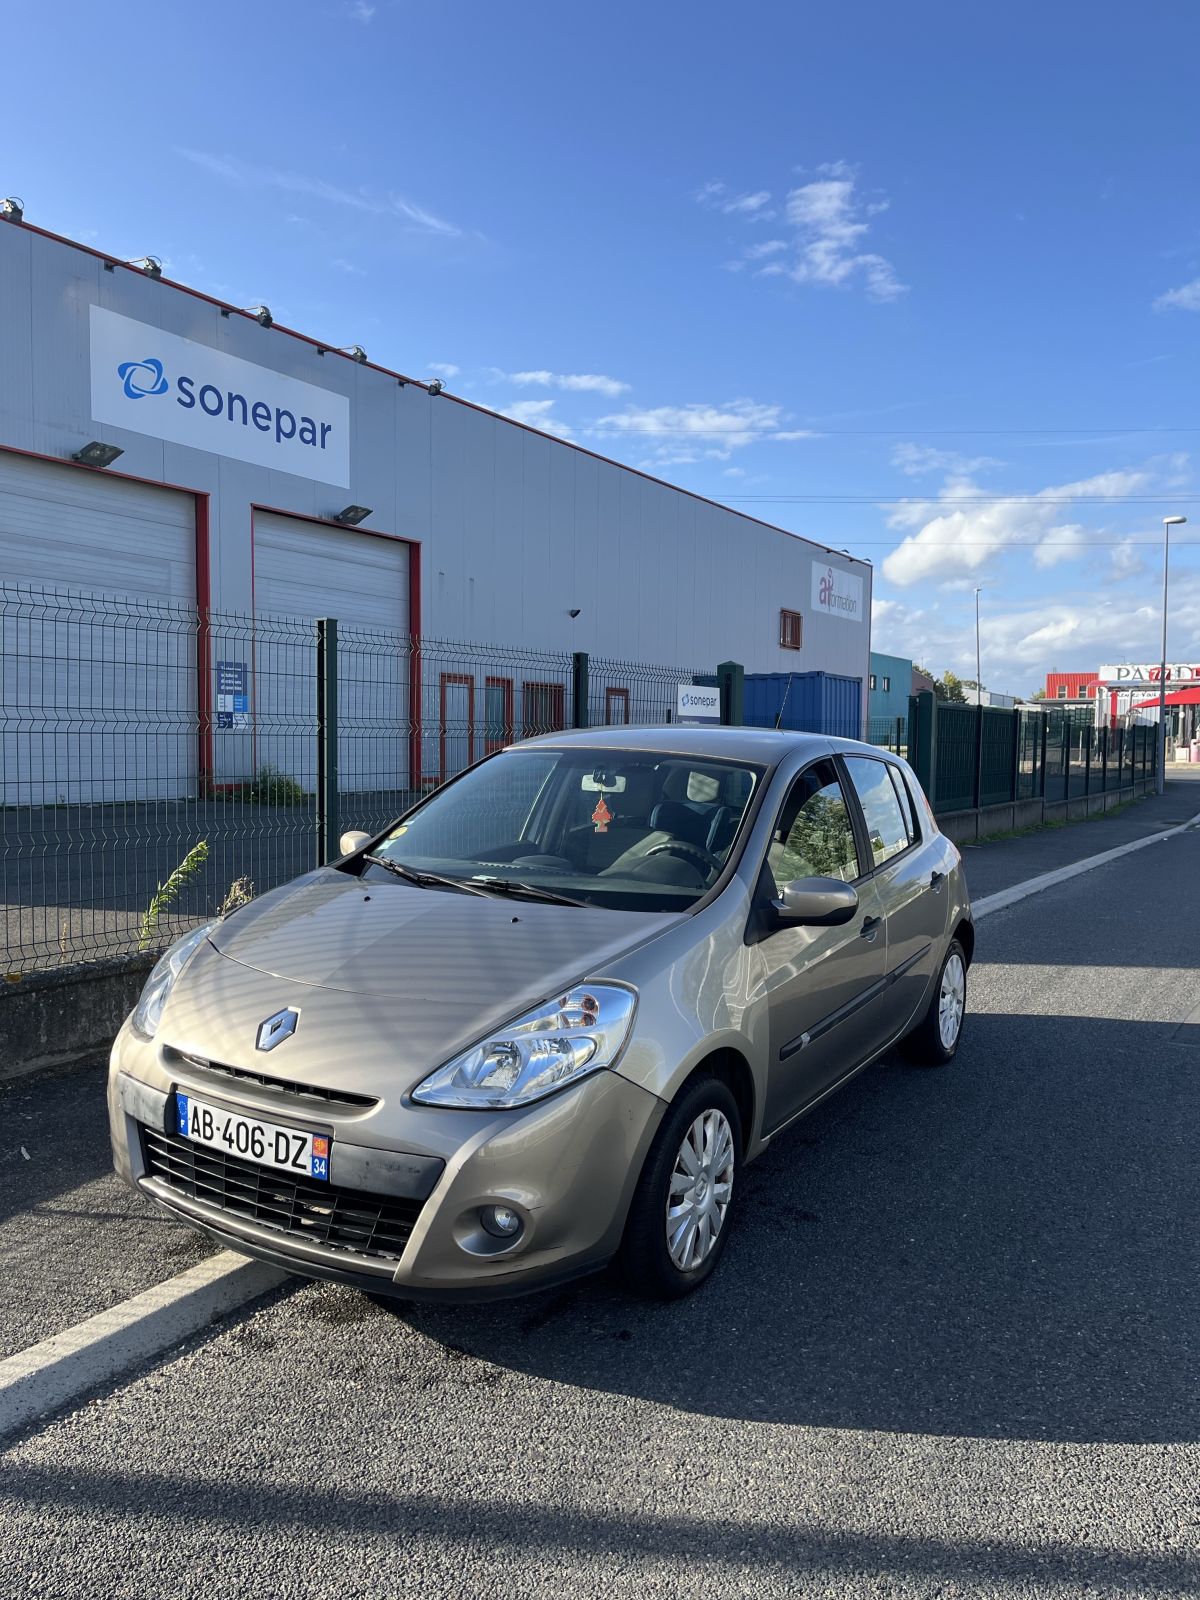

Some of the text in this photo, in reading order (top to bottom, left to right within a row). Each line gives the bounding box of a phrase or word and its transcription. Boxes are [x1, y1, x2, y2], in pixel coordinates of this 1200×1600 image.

[177, 376, 332, 449] sonepar
[690, 696, 717, 707] sonepar
[180, 1120, 185, 1128] F
[191, 1106, 308, 1170] AB-406-DZ
[313, 1158, 326, 1175] 34
